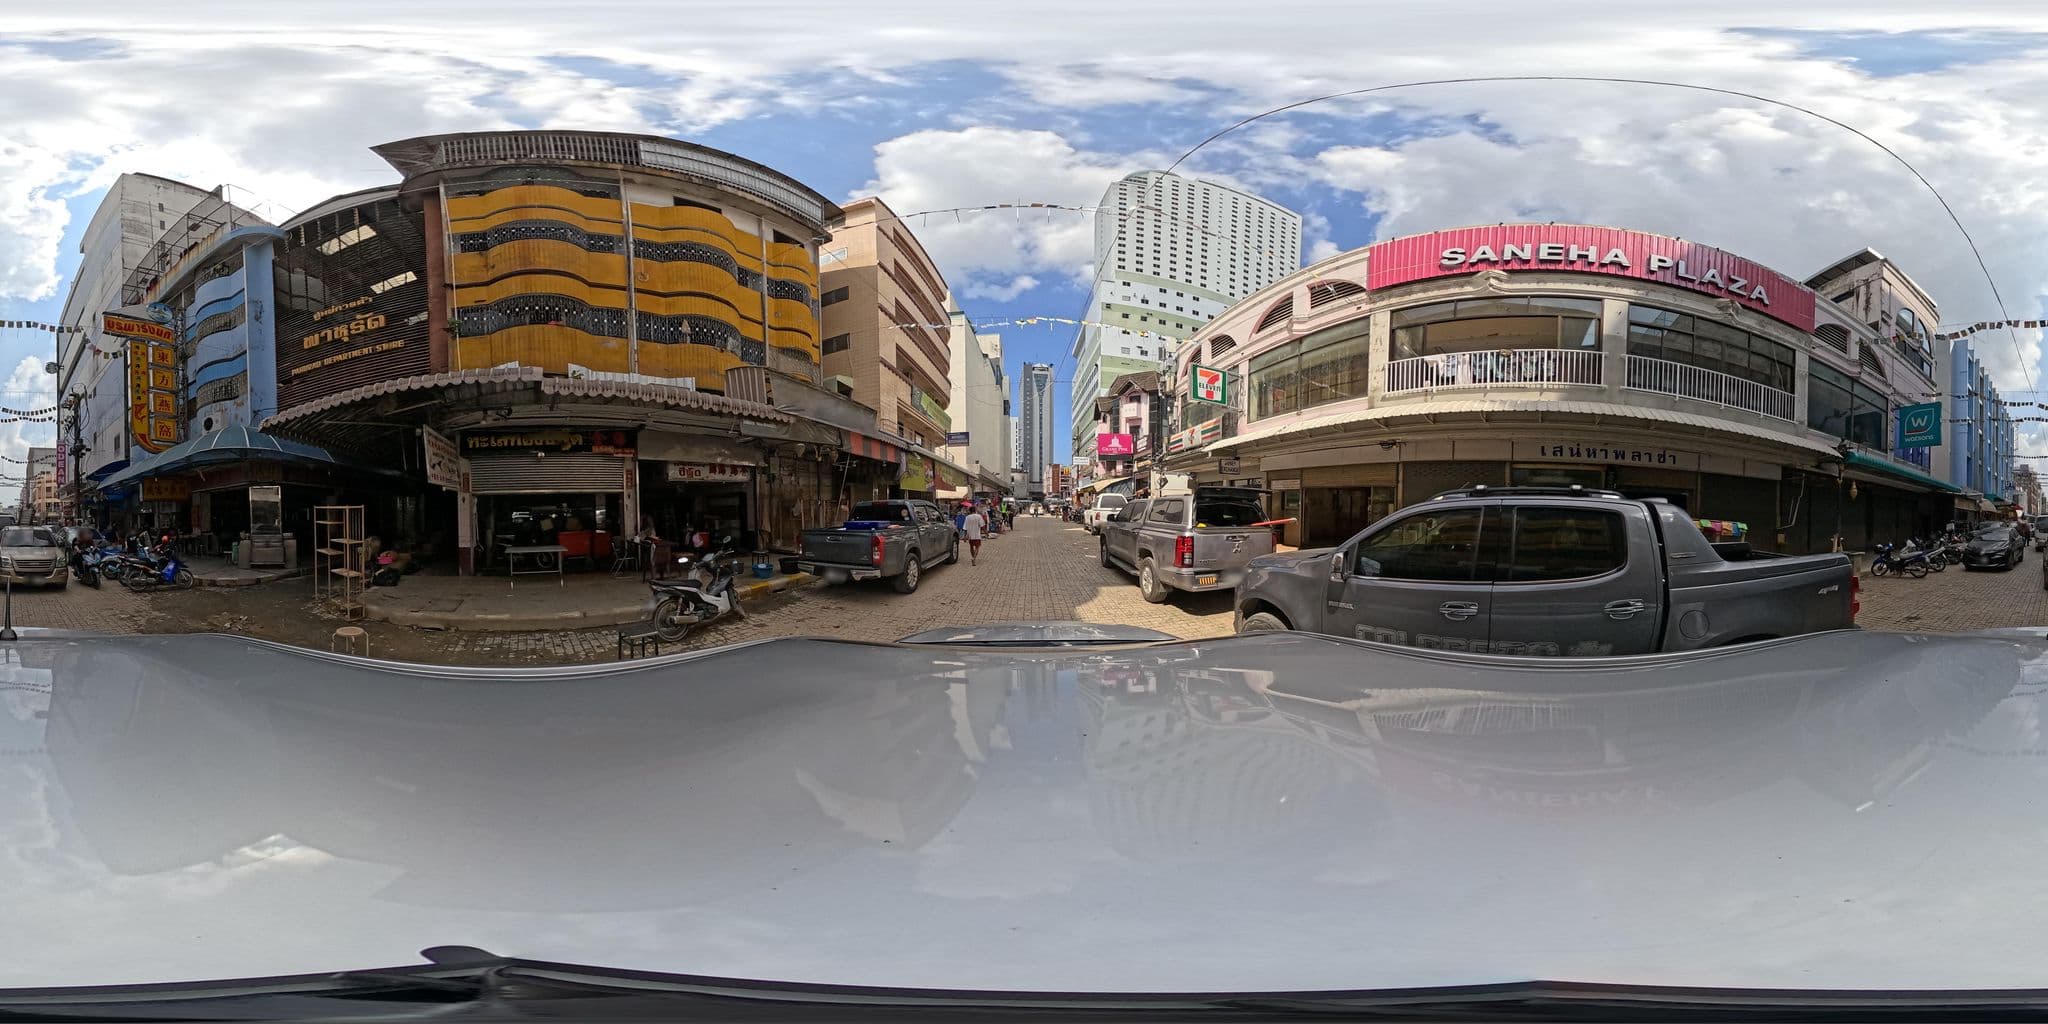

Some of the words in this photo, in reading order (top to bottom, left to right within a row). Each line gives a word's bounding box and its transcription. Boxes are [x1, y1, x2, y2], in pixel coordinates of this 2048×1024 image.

[1440, 243, 1631, 267] SANEHA
[1650, 254, 1770, 305] PLAZA
[303, 312, 386, 350] พาหุรัด
[323, 346, 373, 366] DEPARTMENT
[375, 339, 405, 354] STORE
[1199, 368, 1220, 400] 7
[1904, 434, 1934, 442] watsons
